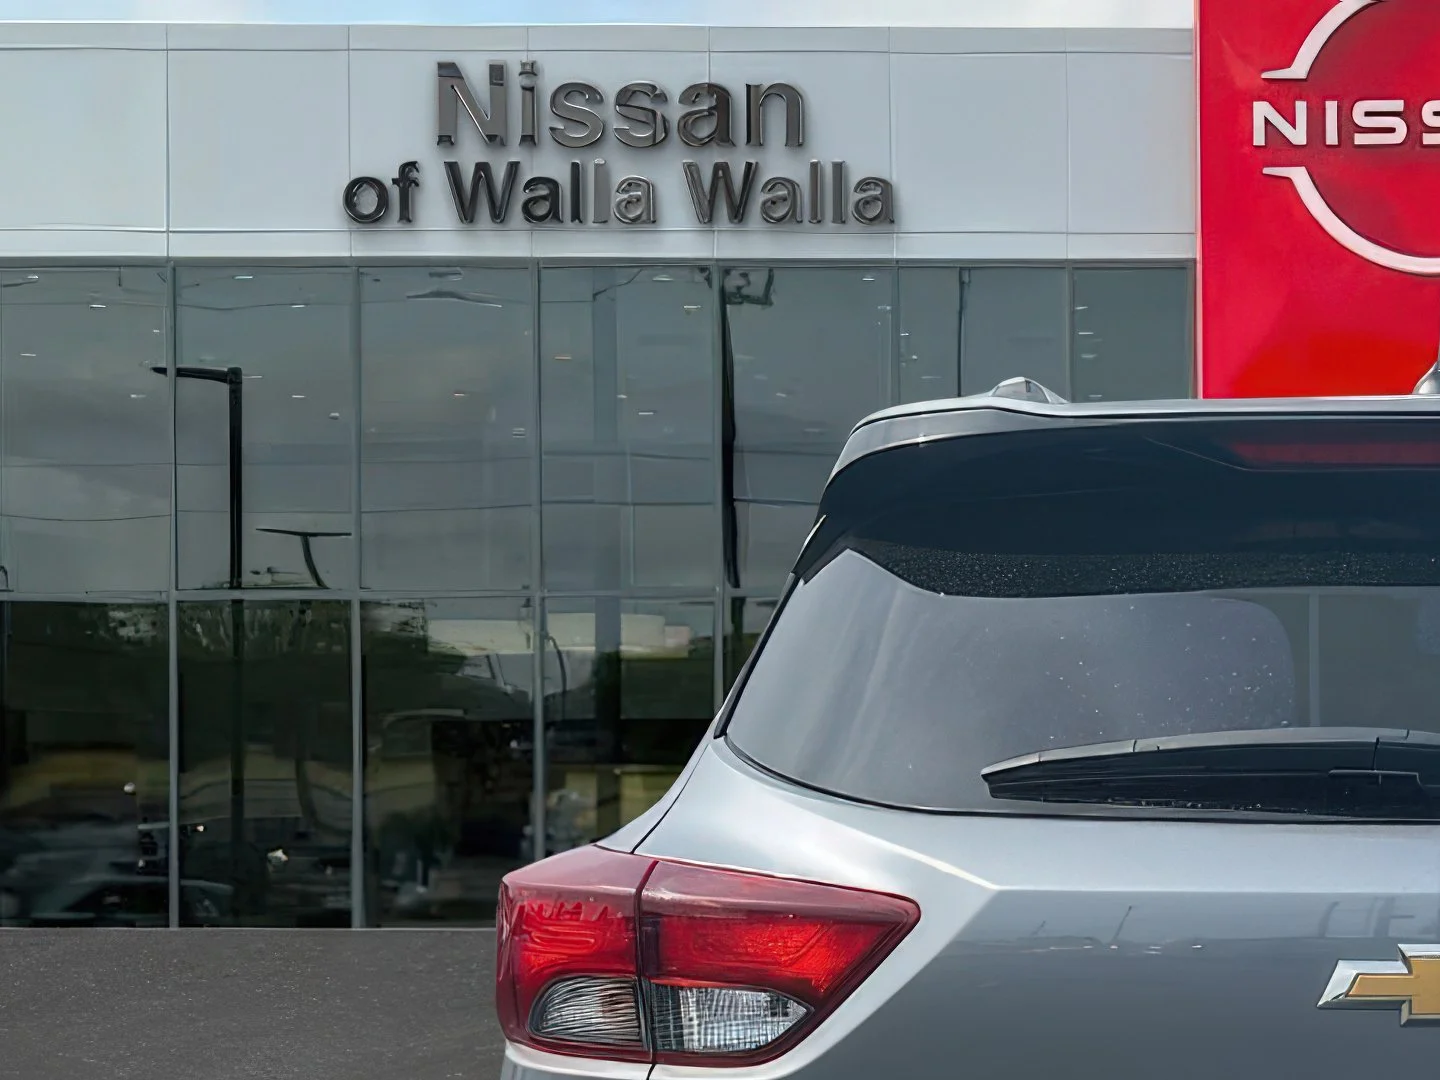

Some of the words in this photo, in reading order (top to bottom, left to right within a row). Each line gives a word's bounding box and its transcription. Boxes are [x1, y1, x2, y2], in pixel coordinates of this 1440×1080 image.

[434, 60, 806, 148] Nissan
[342, 160, 420, 225] of
[443, 159, 657, 225] Walla
[682, 159, 895, 225] Walla
